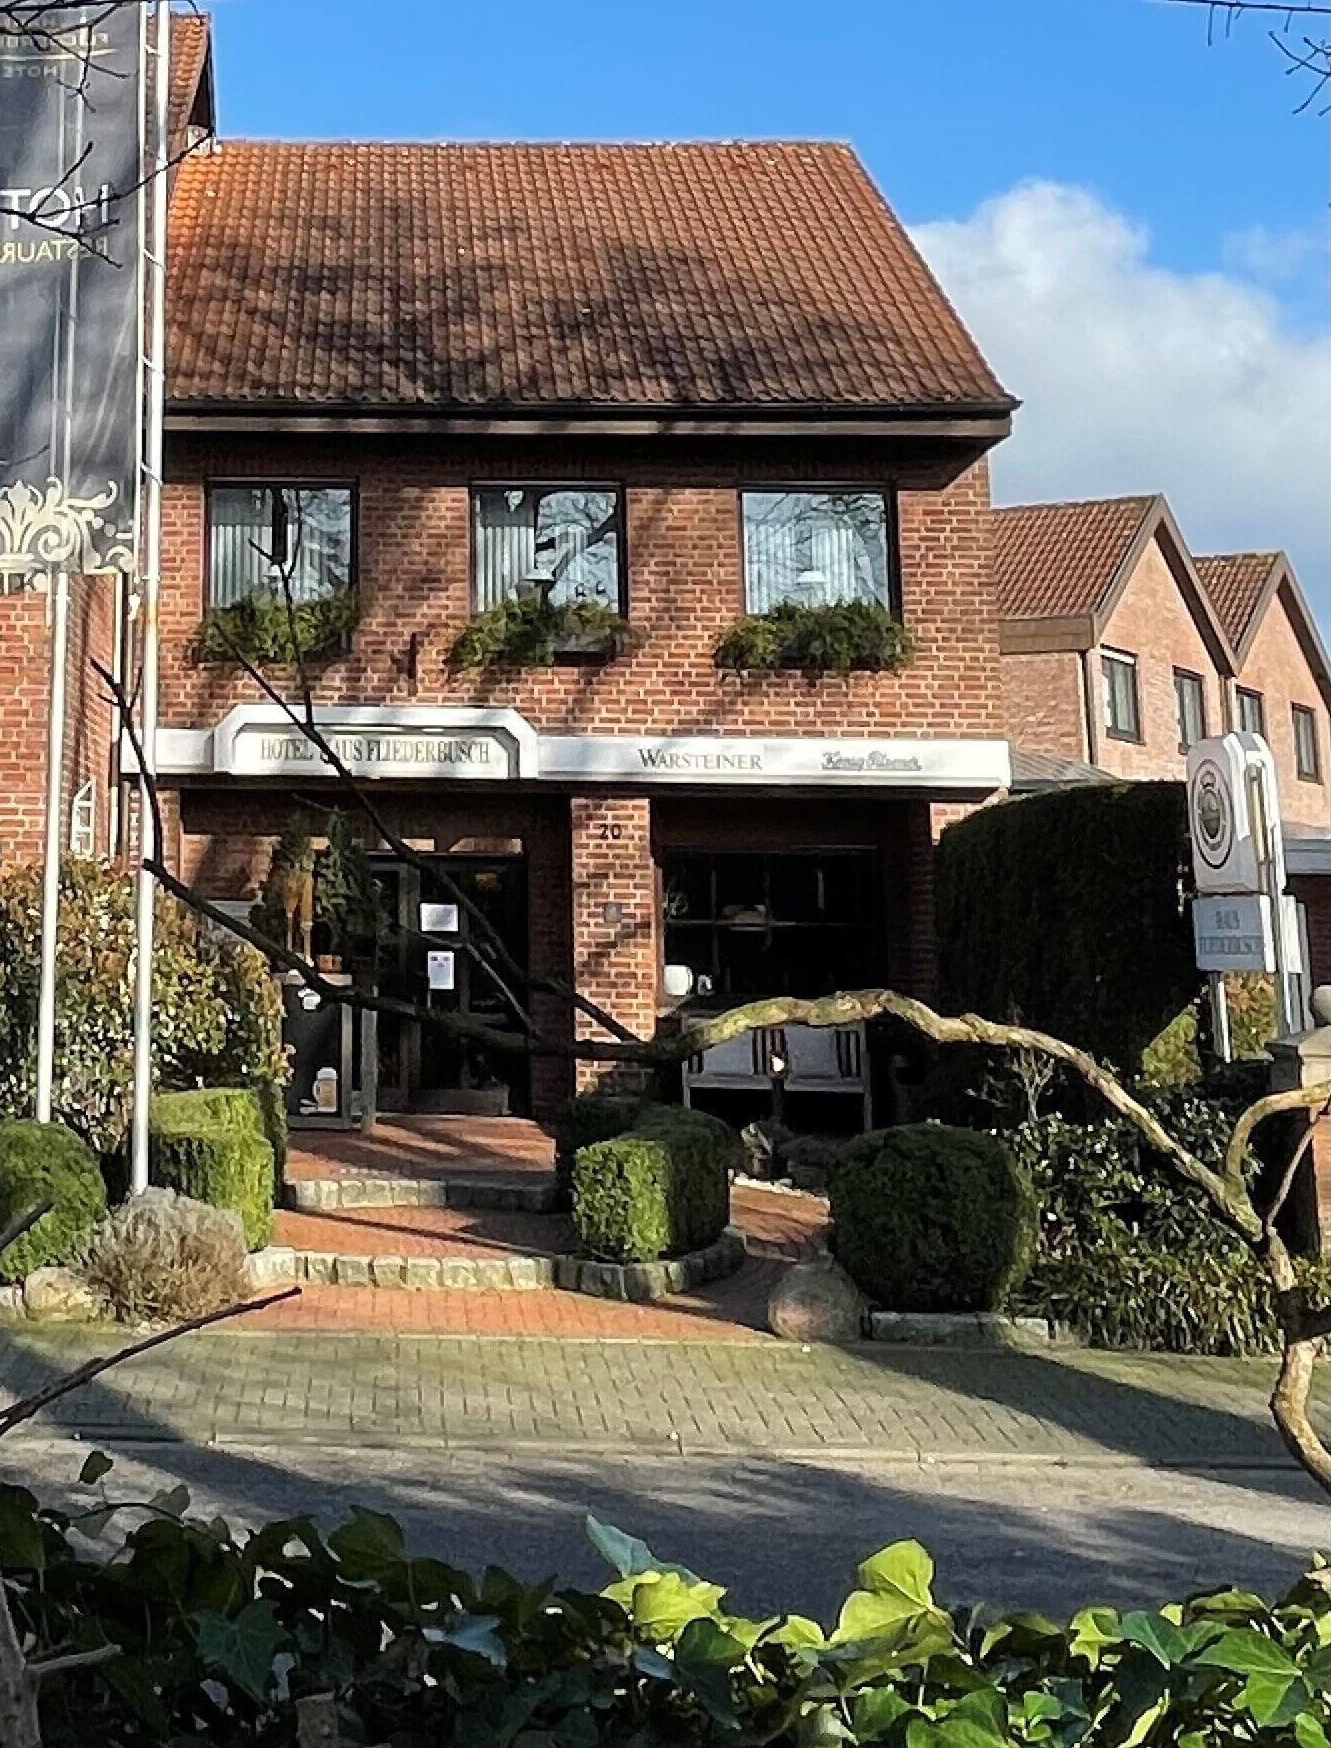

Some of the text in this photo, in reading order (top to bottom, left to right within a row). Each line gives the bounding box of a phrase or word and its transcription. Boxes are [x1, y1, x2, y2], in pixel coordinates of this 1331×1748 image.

[260, 738, 315, 761] HOTEL
[366, 739, 491, 764] FLIEDERBUSCH
[638, 748, 762, 771] WARSTEINER
[598, 822, 622, 840] 20
